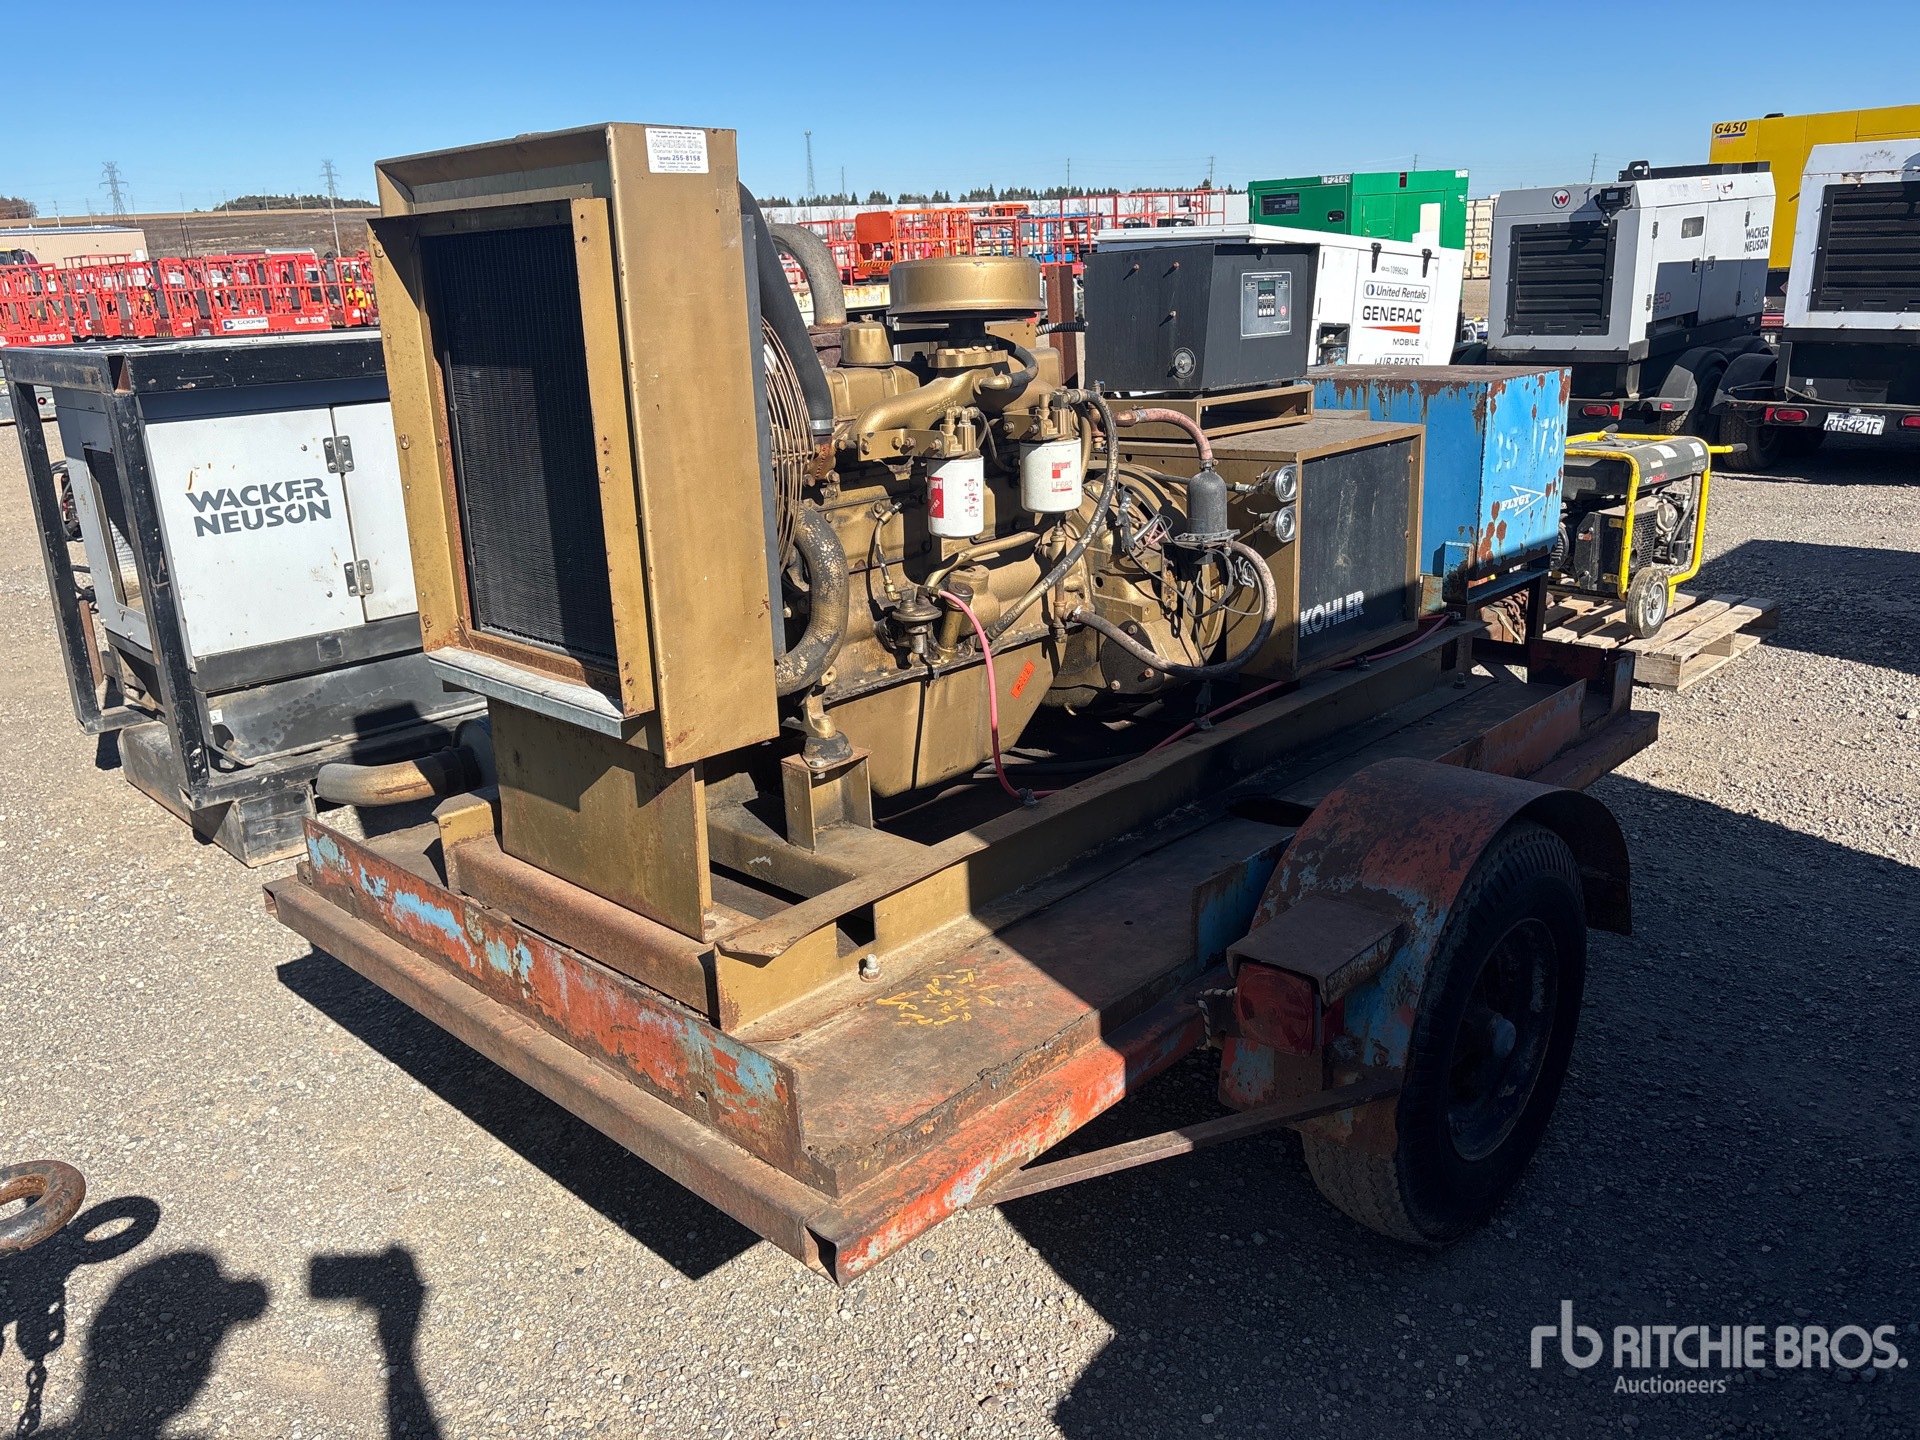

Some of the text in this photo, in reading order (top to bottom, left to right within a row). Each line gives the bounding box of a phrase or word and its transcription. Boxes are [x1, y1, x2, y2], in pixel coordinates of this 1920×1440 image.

[1715, 121, 1748, 134] G450
[1745, 226, 1770, 240] WACKER
[1744, 238, 1769, 253] NEUSON
[1376, 285, 1427, 299] United Rentals
[1362, 305, 1422, 323] GENERAC
[1392, 338, 1420, 346] MOBILE
[185, 477, 329, 513] WACKER
[1500, 493, 1532, 512] FLYGT
[193, 499, 332, 537] NEUSON
[1299, 590, 1365, 638] KOHLER
